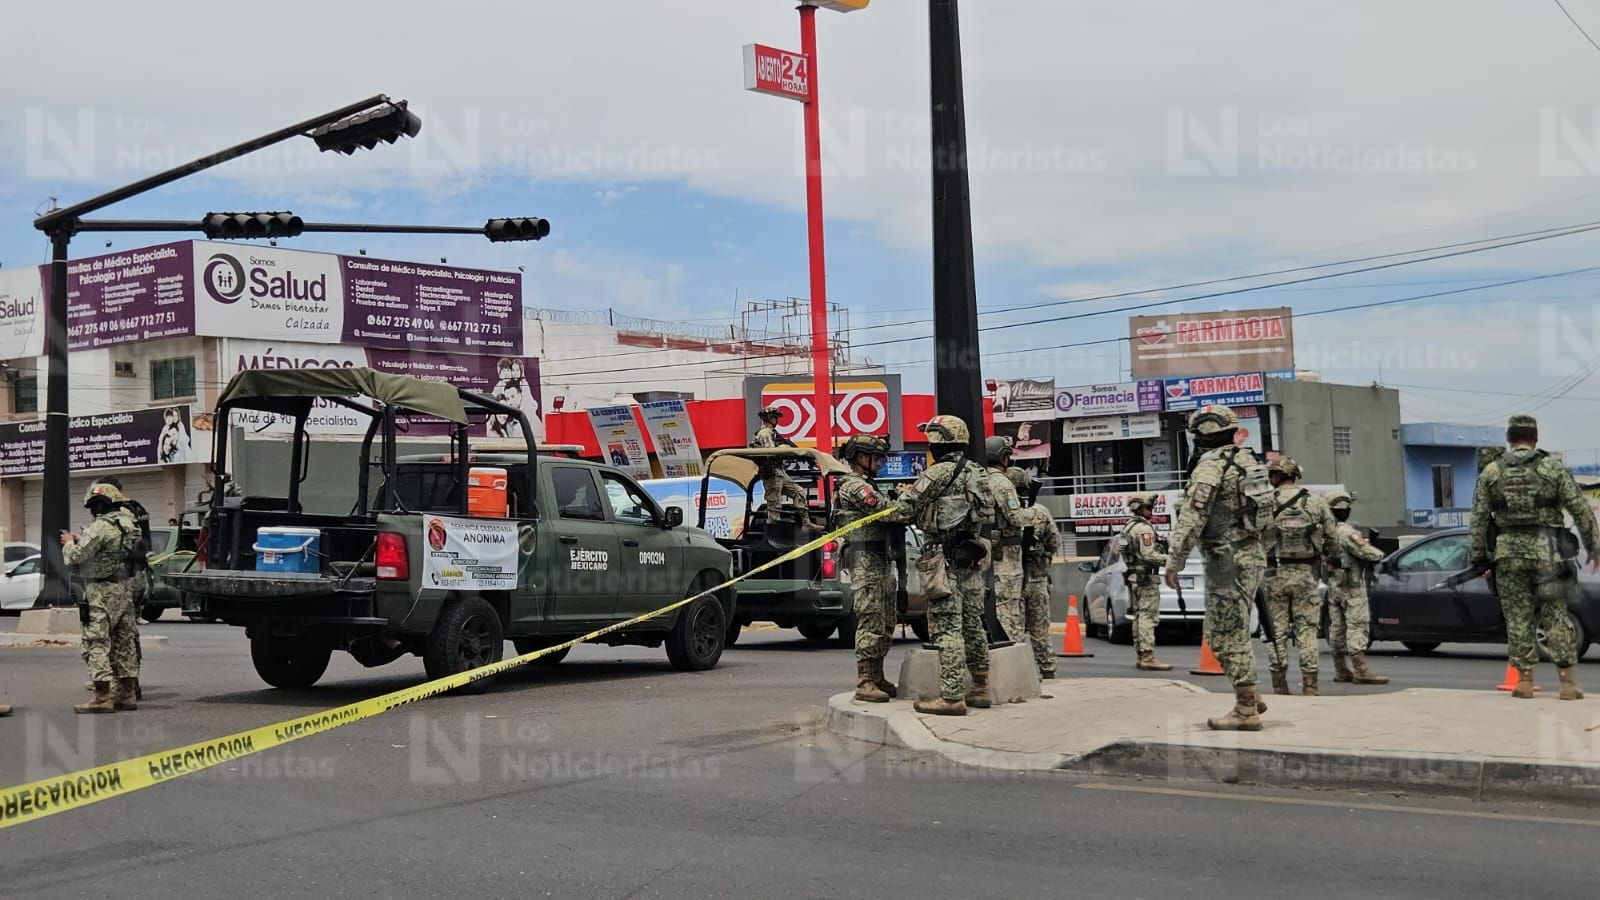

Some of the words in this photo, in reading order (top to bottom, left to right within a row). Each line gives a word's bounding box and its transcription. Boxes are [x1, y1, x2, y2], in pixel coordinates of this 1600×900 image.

[758, 55, 781, 84] ABIERTO
[782, 55, 807, 83] 24
[782, 81, 808, 94] HORAS
[68, 262, 91, 274] nsultas
[93, 260, 102, 269] de
[104, 255, 131, 268] Médico
[133, 247, 178, 264] Especialista,
[250, 256, 276, 267] Somos
[80, 270, 115, 285] Psicología
[123, 263, 155, 278] Nutrición
[347, 260, 380, 271] Consultas
[380, 264, 390, 273] de
[391, 264, 416, 275] Médico
[454, 271, 484, 283] Psicología
[490, 274, 516, 285] Nutrición
[249, 267, 326, 302] Salud
[0, 296, 34, 319] Salud
[250, 297, 281, 311] Damos
[285, 301, 330, 314] bienestar
[84, 322, 98, 335] 275
[99, 320, 108, 333] 49
[109, 319, 119, 331] 06
[126, 316, 139, 329] 667
[141, 314, 154, 326] 712
[155, 312, 165, 325] 77
[166, 311, 175, 323] 51
[285, 317, 330, 331] Calzada
[376, 315, 391, 327] 667
[393, 316, 410, 328] 275
[411, 318, 423, 329] 49
[424, 319, 435, 330] 06
[447, 321, 462, 332] 667
[464, 322, 480, 333] 712
[481, 323, 490, 334] 77
[492, 324, 502, 335] 51
[1177, 316, 1285, 344] FARMACIA
[1091, 385, 1117, 393] Somos
[1190, 374, 1262, 397] FARMACIA
[1075, 390, 1135, 407] Farmacia
[19, 421, 47, 433] Consult
[69, 417, 90, 429] édico
[92, 413, 134, 428] Especialista
[263, 412, 276, 424] de
[280, 414, 292, 425] 90
[306, 414, 358, 426] pecialistas
[694, 494, 726, 508] BMBO
[1074, 495, 1123, 509] BALEROS
[1098, 507, 1112, 515] PICK
[706, 515, 729, 530] EDIAS
[463, 533, 506, 545] ANONIMA
[570, 547, 608, 562] EJÉRCITO
[639, 551, 665, 565] 0890314
[571, 561, 608, 571] MEXICANO
